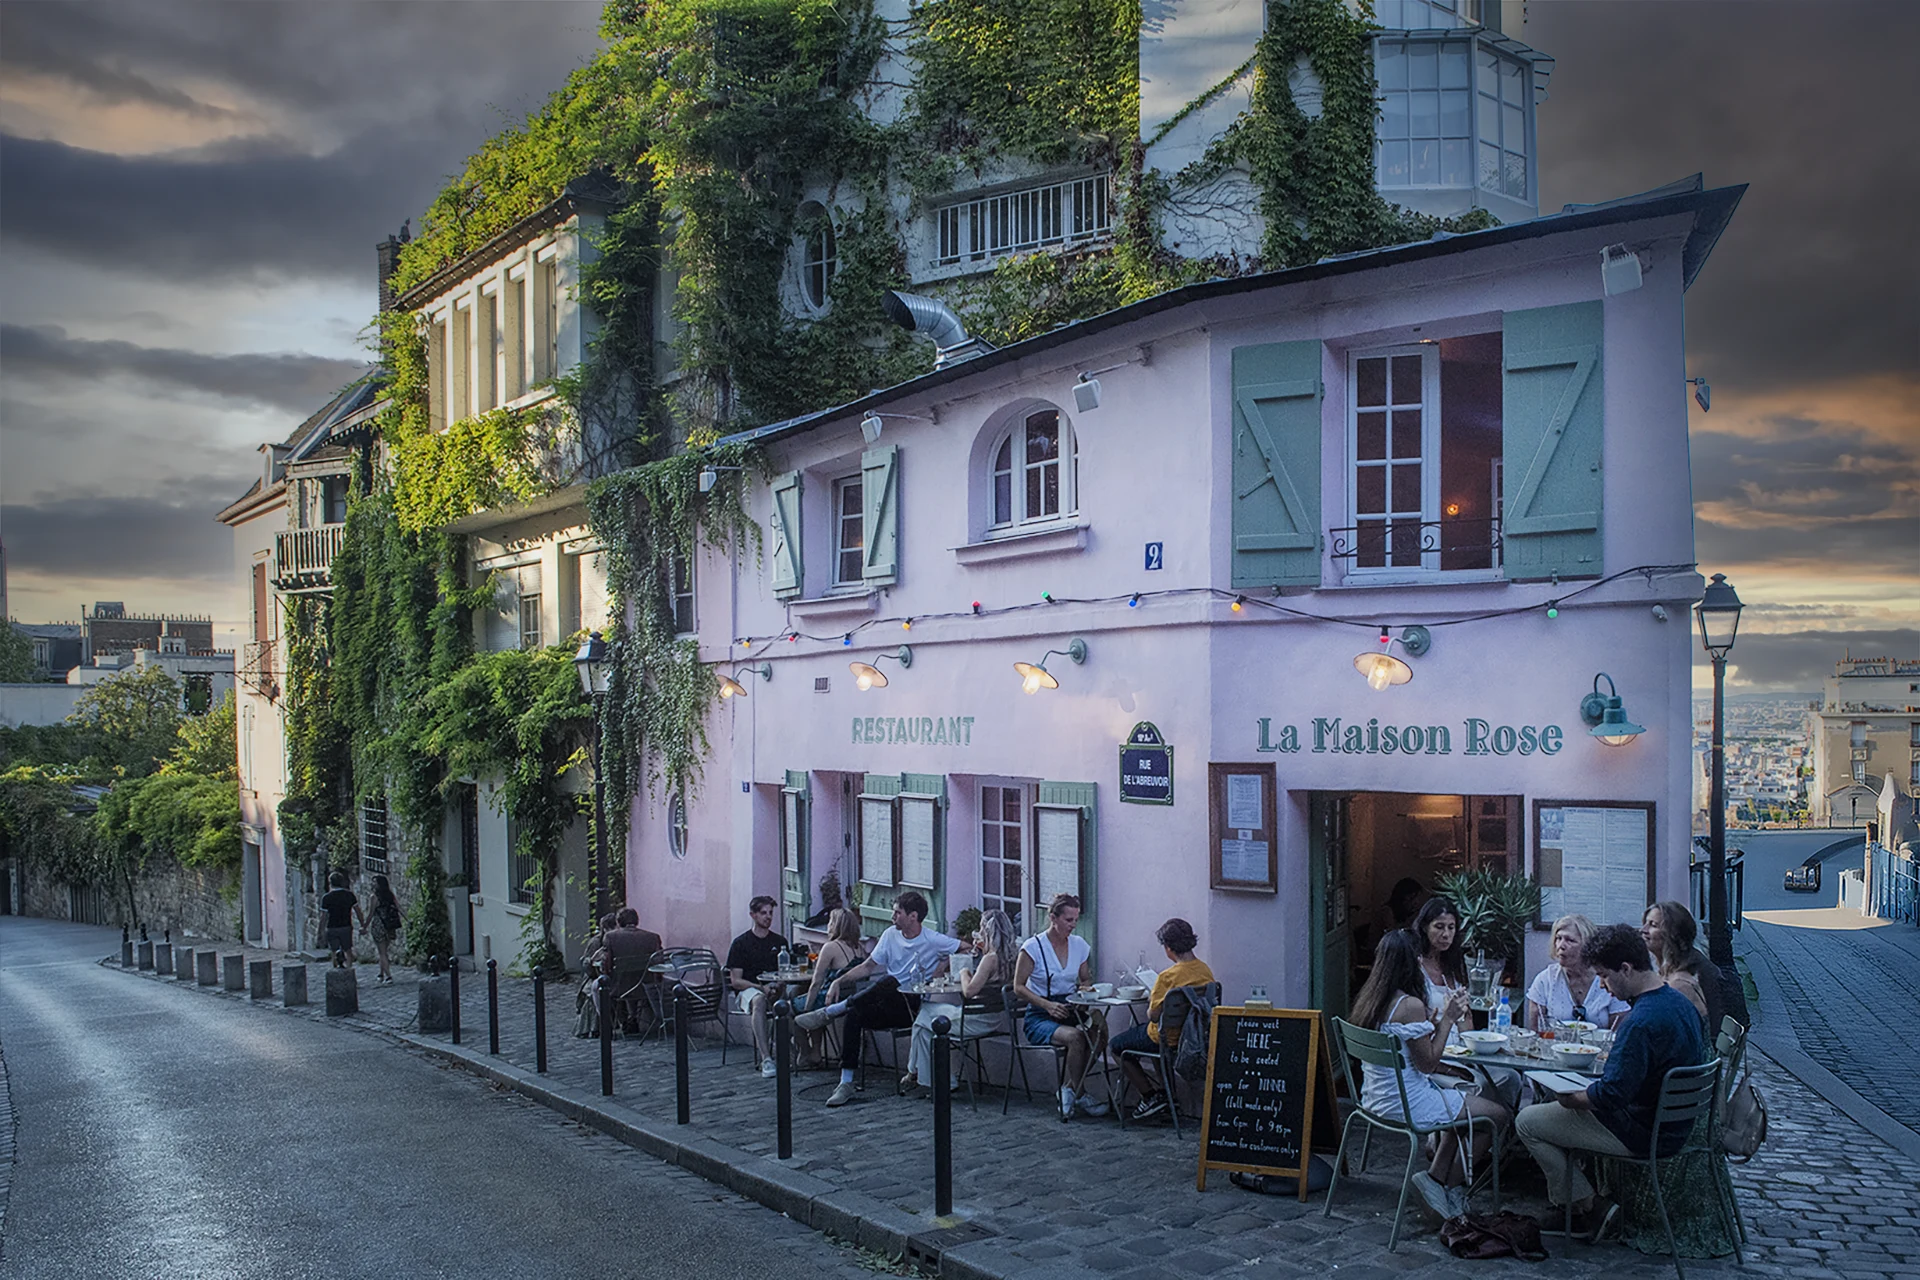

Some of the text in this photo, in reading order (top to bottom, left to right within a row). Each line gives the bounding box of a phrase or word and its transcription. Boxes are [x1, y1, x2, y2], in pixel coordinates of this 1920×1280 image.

[1148, 544, 1159, 569] 2
[851, 716, 975, 746] RESTAURANT
[1256, 717, 1564, 757] La Maison Rose
[1138, 759, 1152, 770] RUE
[1123, 775, 1169, 787] DE L'ABREUVOIR
[1236, 1017, 1280, 1034] please wait
[1246, 1032, 1272, 1049] HERE
[1230, 1050, 1280, 1066] to be seated
[1216, 1078, 1287, 1094] open for DINNER
